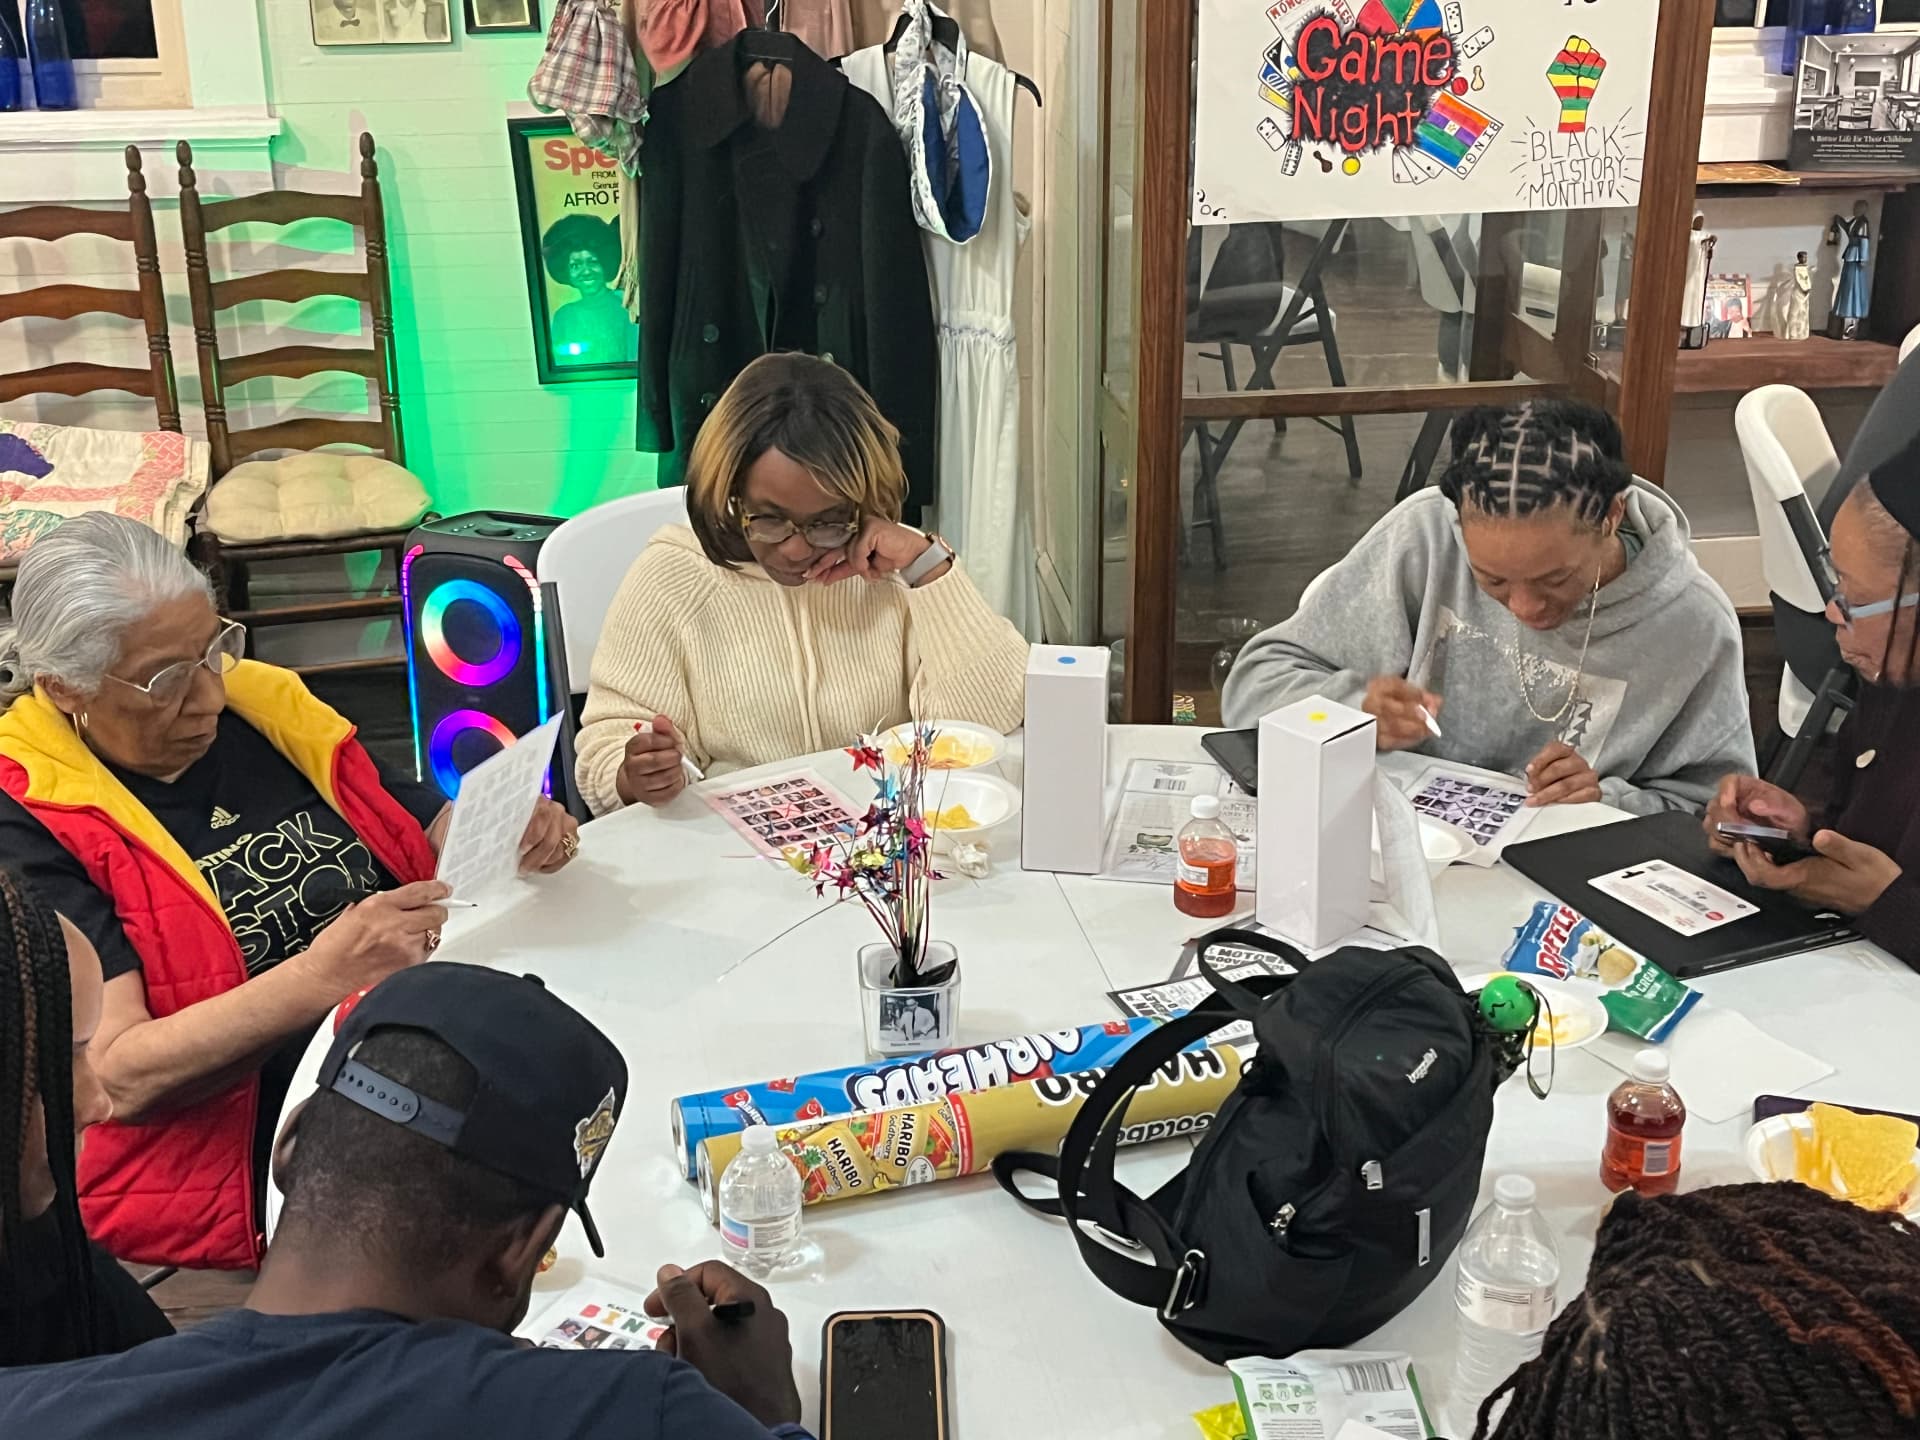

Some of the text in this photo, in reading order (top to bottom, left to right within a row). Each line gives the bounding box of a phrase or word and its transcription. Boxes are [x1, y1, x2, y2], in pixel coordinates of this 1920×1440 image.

[1270, 0, 1302, 19] MONO
[1296, 16, 1454, 86] Game
[1292, 85, 1421, 152] Night
[1531, 126, 1624, 161] BLACK
[544, 139, 618, 176] Spe
[1455, 121, 1501, 176] BINGO
[1541, 154, 1625, 185] HISTORY
[564, 191, 609, 207] AFRO
[209, 811, 343, 912] ACK
[229, 842, 378, 968] STOR
[1038, 1049, 1223, 1101] HABO
[827, 1136, 861, 1189] HARIBO
[896, 1113, 915, 1168] HARIBO
